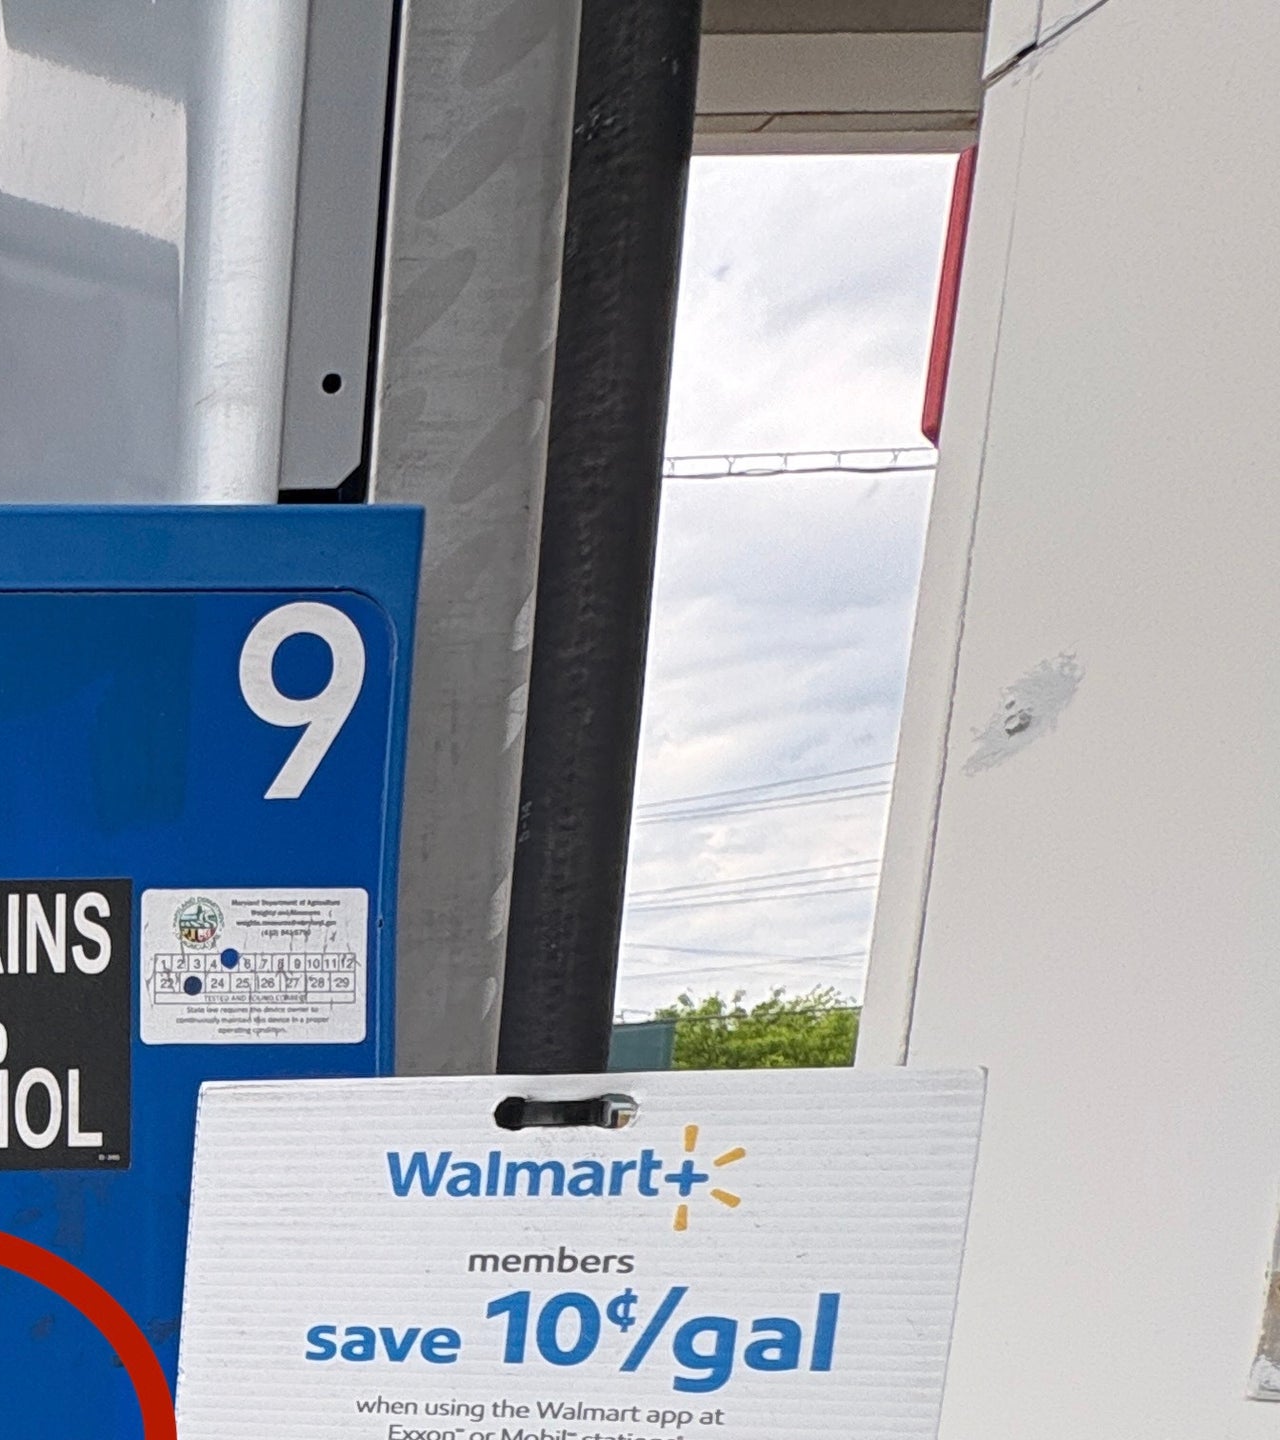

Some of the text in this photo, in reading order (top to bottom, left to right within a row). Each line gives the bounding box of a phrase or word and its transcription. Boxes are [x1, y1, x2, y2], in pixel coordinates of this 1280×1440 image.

[240, 602, 365, 799] 9
[211, 978, 349, 988] 24 25 29
[468, 1248, 635, 1274] members
[305, 1286, 842, 1393] save 10¢/gal
[355, 1396, 725, 1431] when using the Walmart app at
